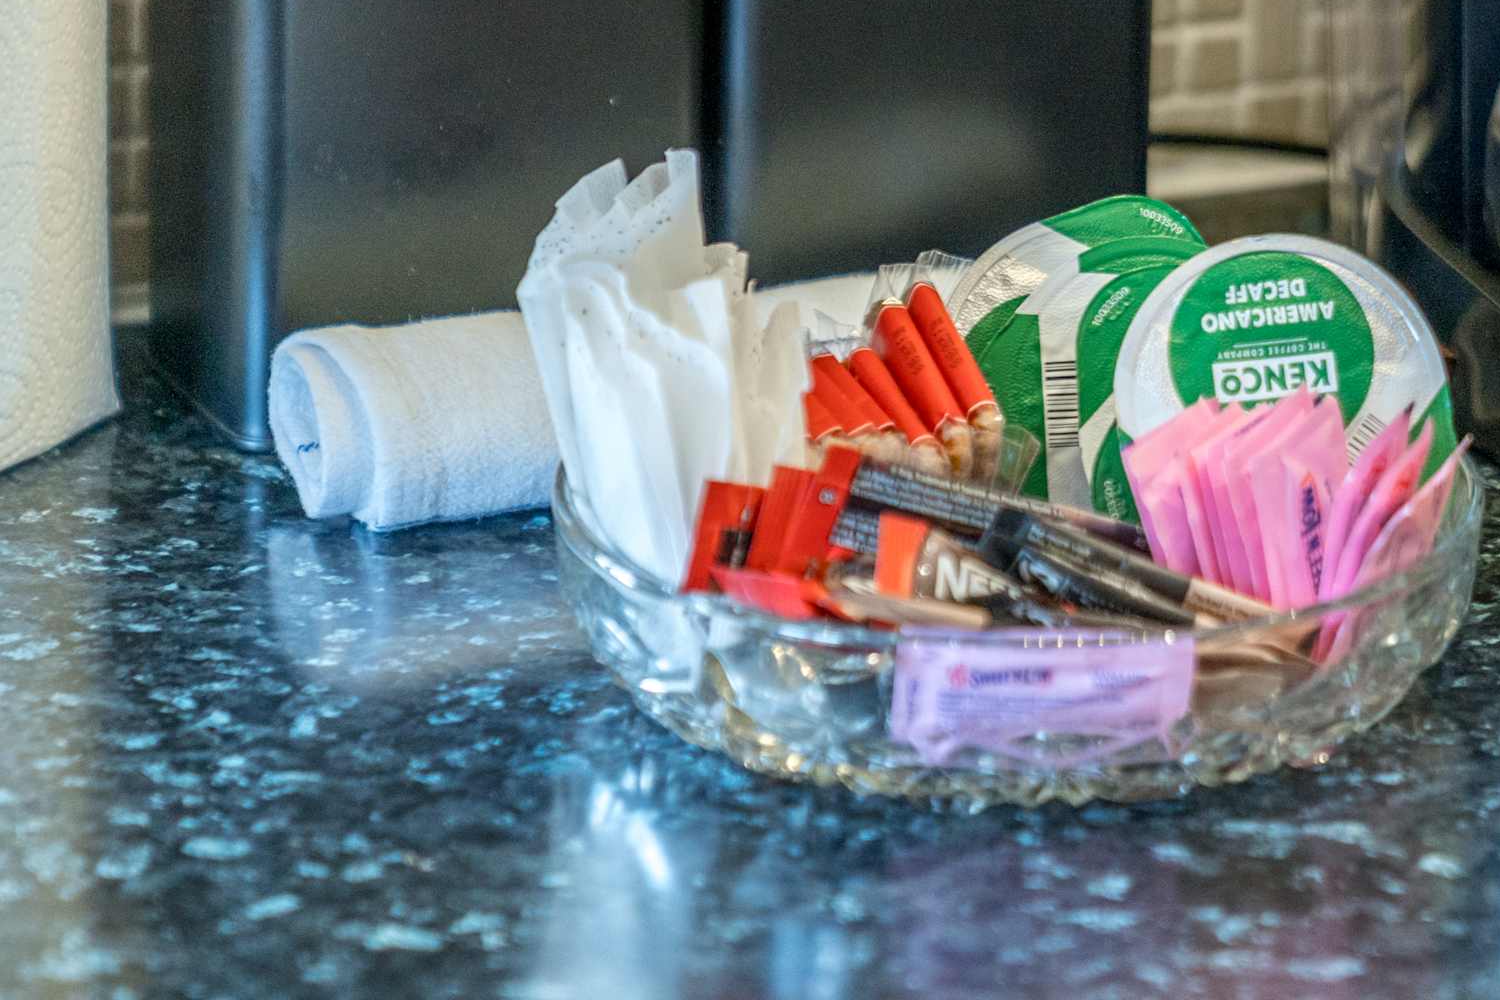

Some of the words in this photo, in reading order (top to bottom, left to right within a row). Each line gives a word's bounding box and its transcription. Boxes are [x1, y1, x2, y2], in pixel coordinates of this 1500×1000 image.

[1224, 277, 1307, 305] DECAFF
[1200, 300, 1335, 334] AMERICANO
[1216, 348, 1266, 360] COMPANY
[1267, 343, 1305, 357] COFFEE
[1307, 341, 1328, 351] THE
[1220, 359, 1331, 396] KENCO
